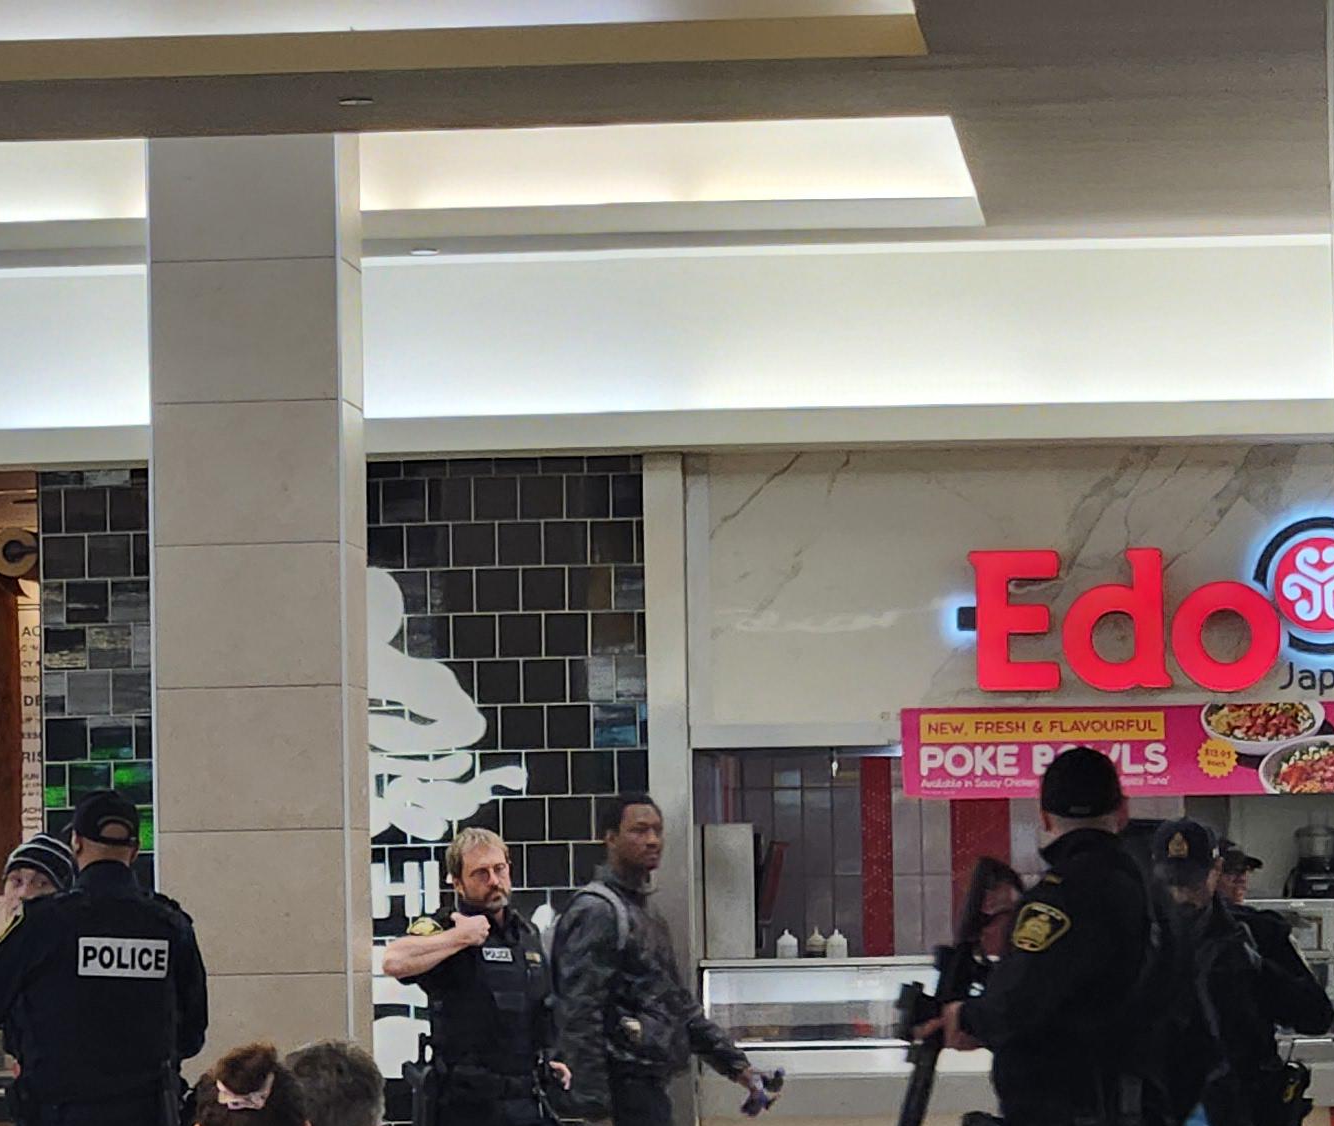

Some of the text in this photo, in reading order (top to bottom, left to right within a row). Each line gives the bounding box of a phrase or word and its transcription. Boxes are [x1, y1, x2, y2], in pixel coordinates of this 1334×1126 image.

[968, 547, 1281, 693] Edo
[927, 718, 1157, 736] NEW, FRESH & FLAVOURFUL
[919, 743, 1168, 776] POKE BLS
[921, 778, 962, 789] Available
[83, 946, 166, 971] POLICE
